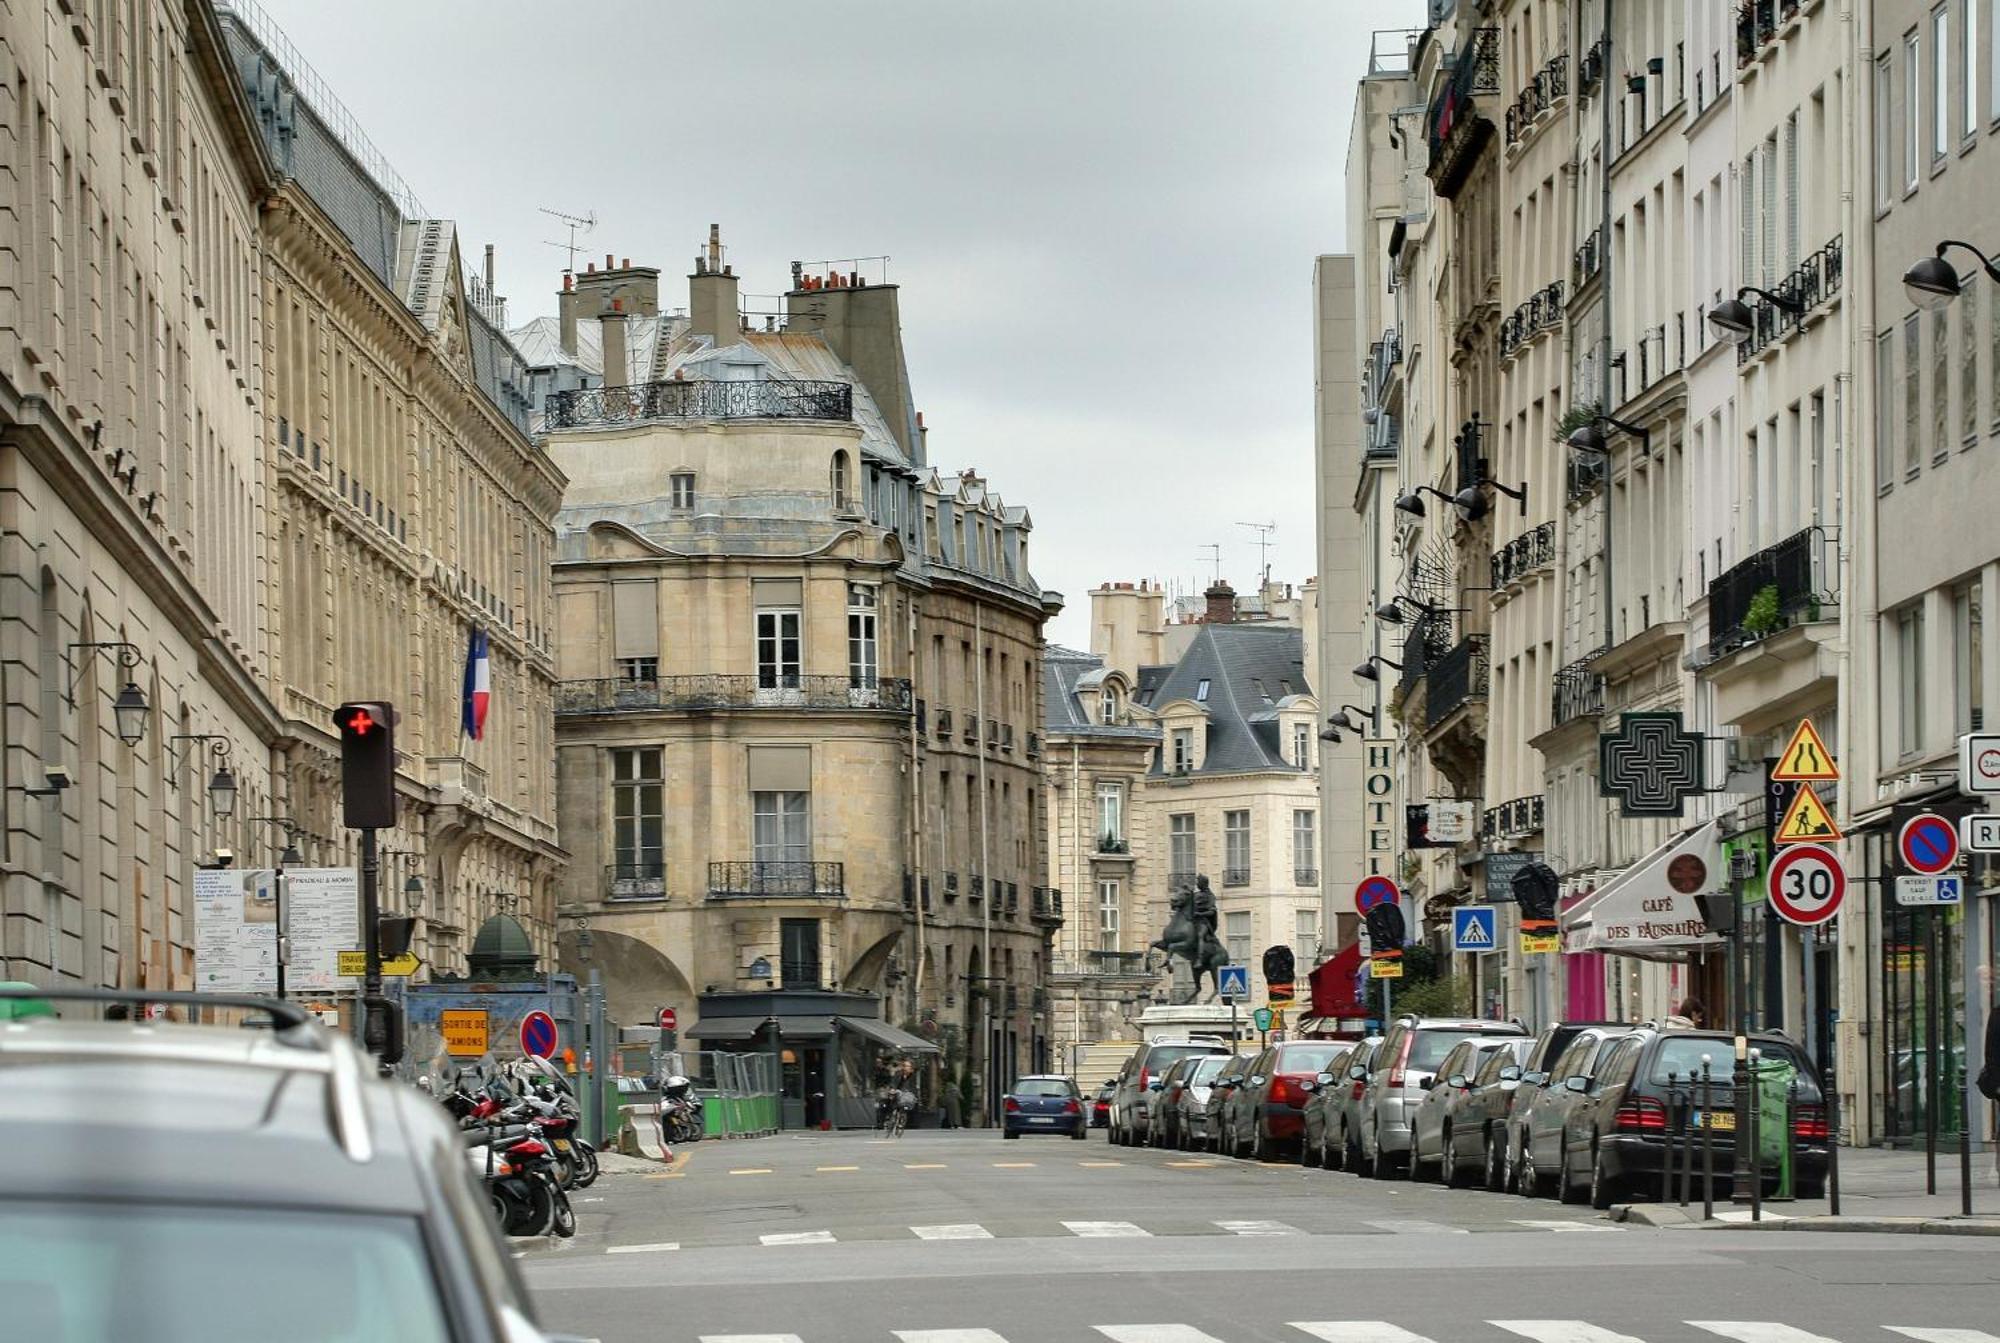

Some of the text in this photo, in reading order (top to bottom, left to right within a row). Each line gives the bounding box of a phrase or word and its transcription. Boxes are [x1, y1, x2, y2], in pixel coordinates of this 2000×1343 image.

[1981, 826, 2000, 841] R
[1785, 869, 1830, 900] 30
[1642, 897, 1674, 912] CAFÉ
[1606, 920, 1707, 940] DES FAUSSAIRE
[444, 1019, 486, 1029] SORTIE DE
